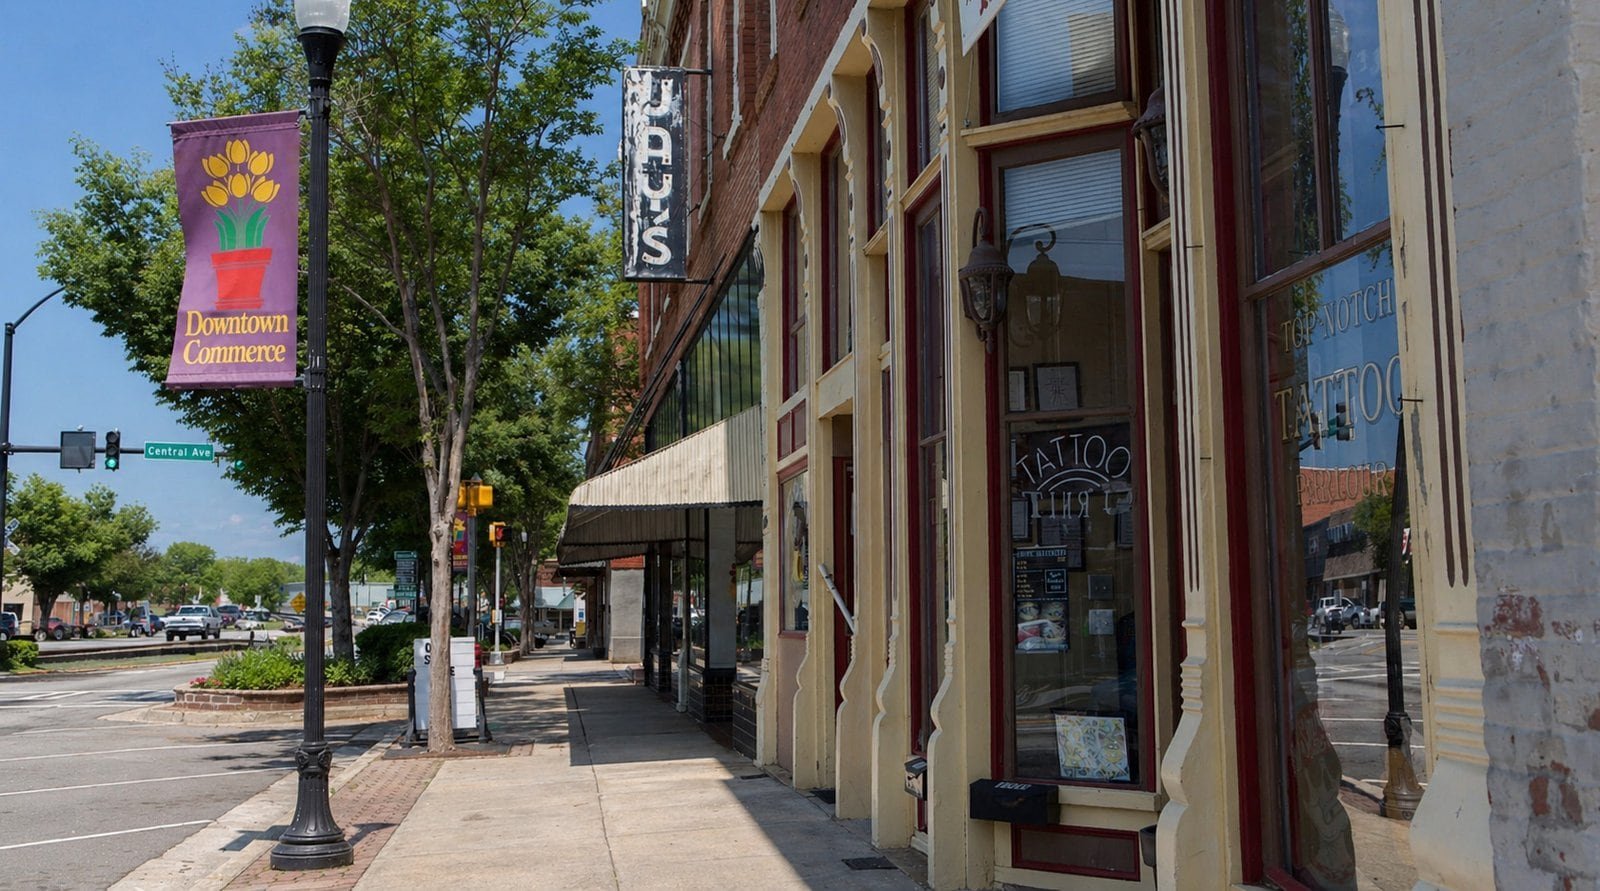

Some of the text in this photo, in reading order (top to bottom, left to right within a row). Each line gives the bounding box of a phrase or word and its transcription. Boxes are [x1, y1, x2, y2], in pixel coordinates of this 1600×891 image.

[185, 310, 289, 337] Downtown
[1280, 278, 1394, 353] TOP NOTCH
[183, 339, 286, 365] Commerce
[148, 446, 211, 457] Central Ave
[1015, 433, 1131, 484] TATTOO
